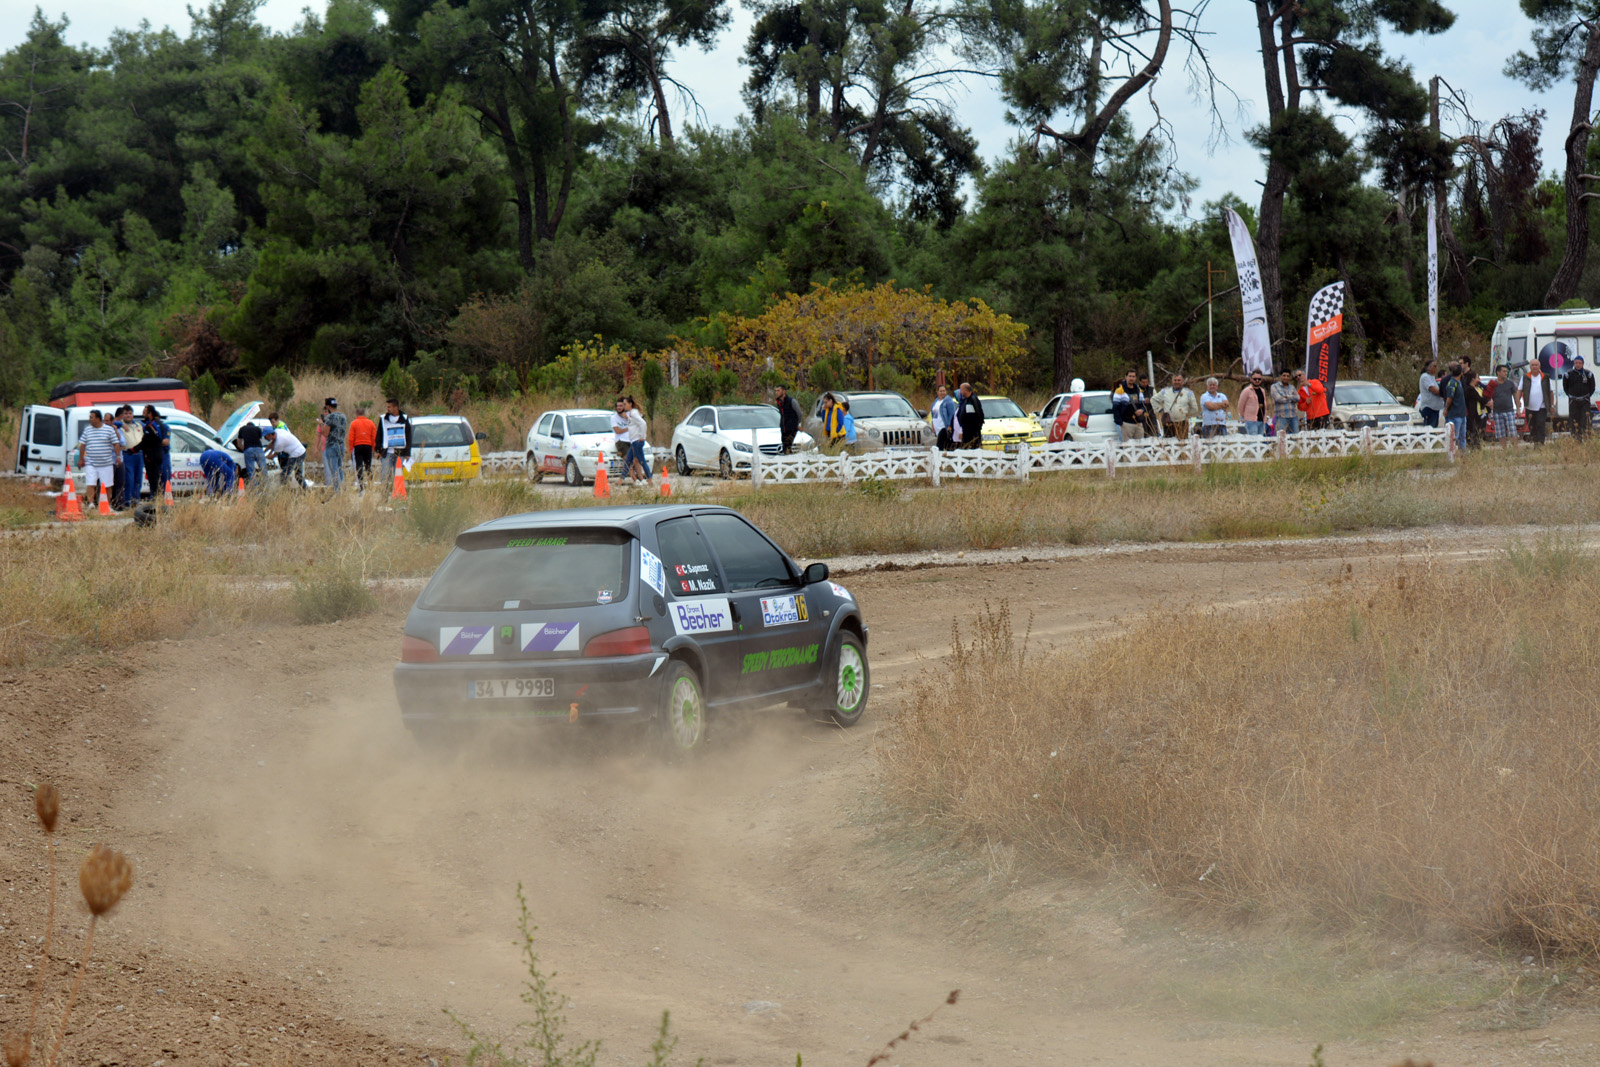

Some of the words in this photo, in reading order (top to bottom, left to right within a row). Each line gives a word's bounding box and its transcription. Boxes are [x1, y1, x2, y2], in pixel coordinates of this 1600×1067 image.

[1318, 342, 1329, 382] SERVIS
[507, 538, 537, 548] SPEEDY
[536, 537, 568, 546] GARAGE
[687, 564, 709, 575] Sapmaz
[688, 579, 698, 591] M.
[697, 578, 716, 591] Nazik
[795, 594, 808, 620] 16
[677, 603, 724, 631] Becher
[764, 611, 798, 624] Otokros
[741, 650, 770, 675] SPEEDY
[767, 643, 820, 670] PERFORMANCE
[476, 680, 494, 697] 34
[501, 680, 509, 696] Y
[515, 679, 554, 696] 9998
